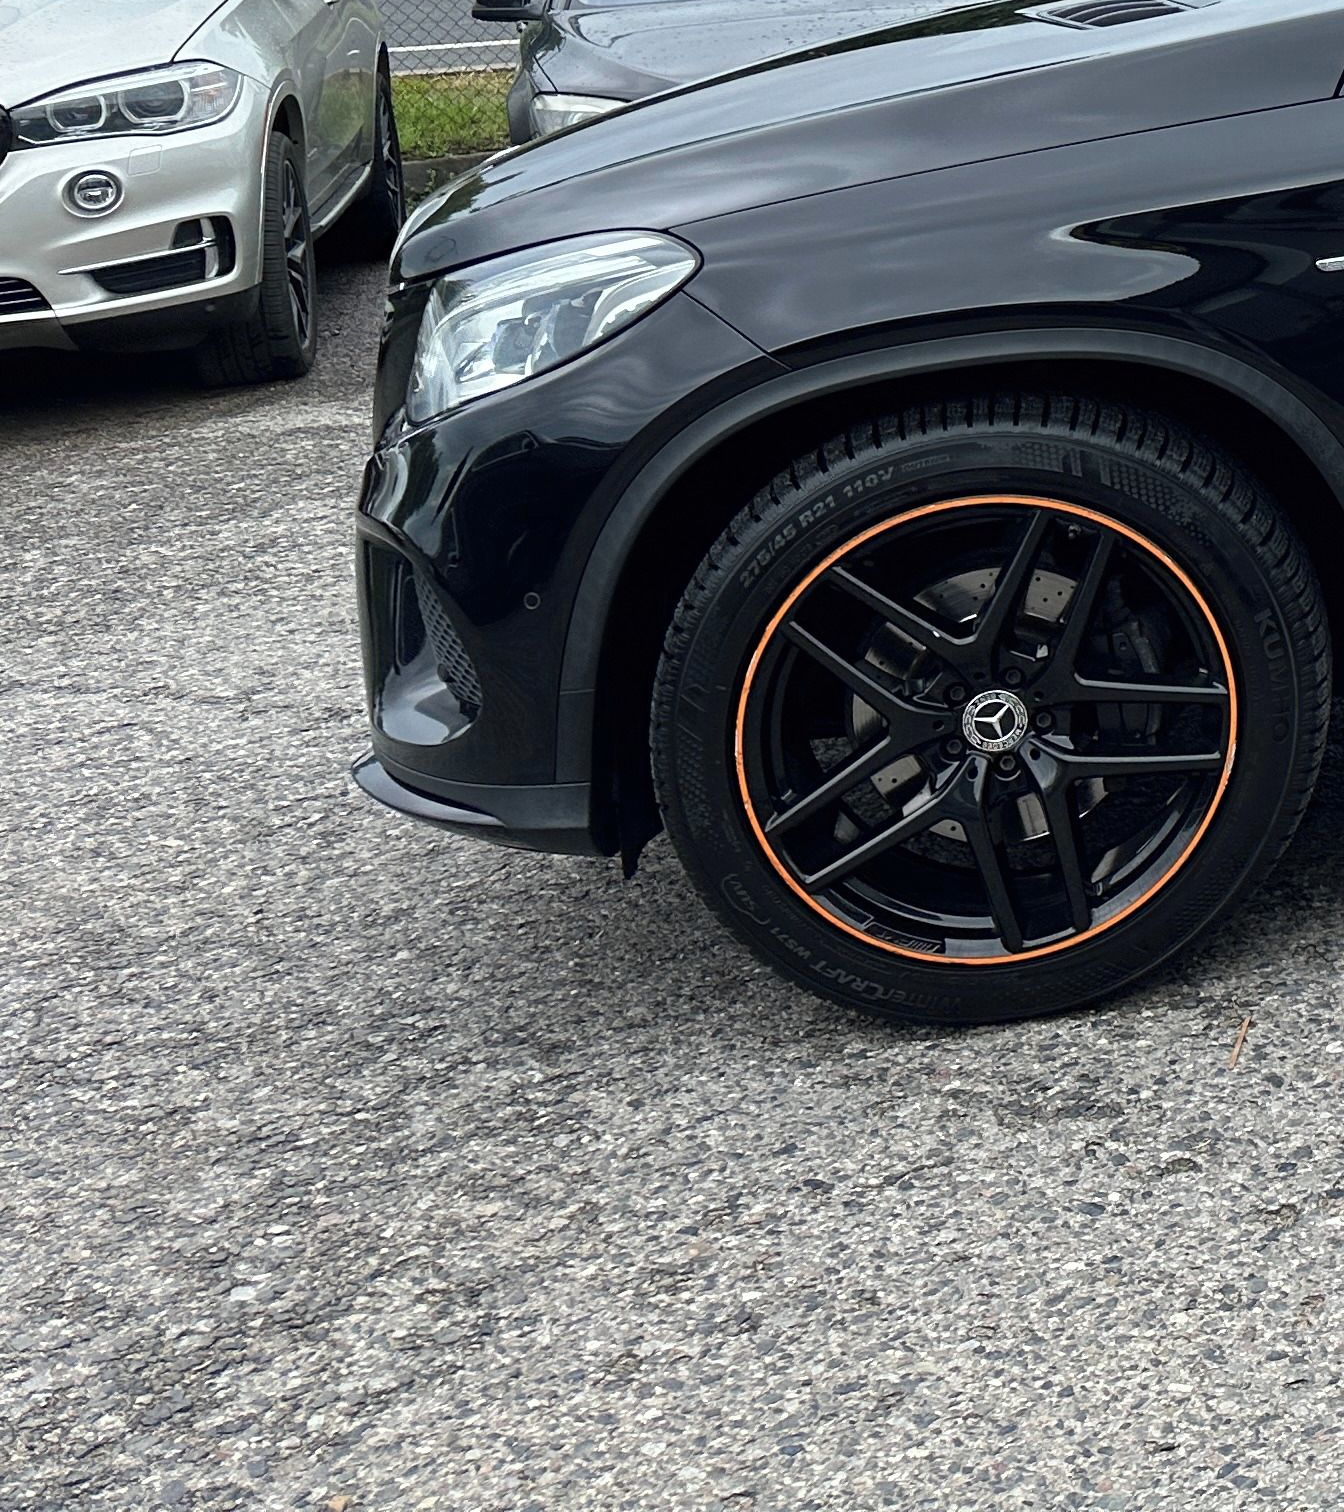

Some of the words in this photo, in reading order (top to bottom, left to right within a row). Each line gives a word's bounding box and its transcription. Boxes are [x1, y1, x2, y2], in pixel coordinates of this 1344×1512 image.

[738, 522, 799, 589] 275/45
[798, 494, 837, 528] R21
[841, 465, 896, 498] 110V
[769, 925, 811, 960] WS71
